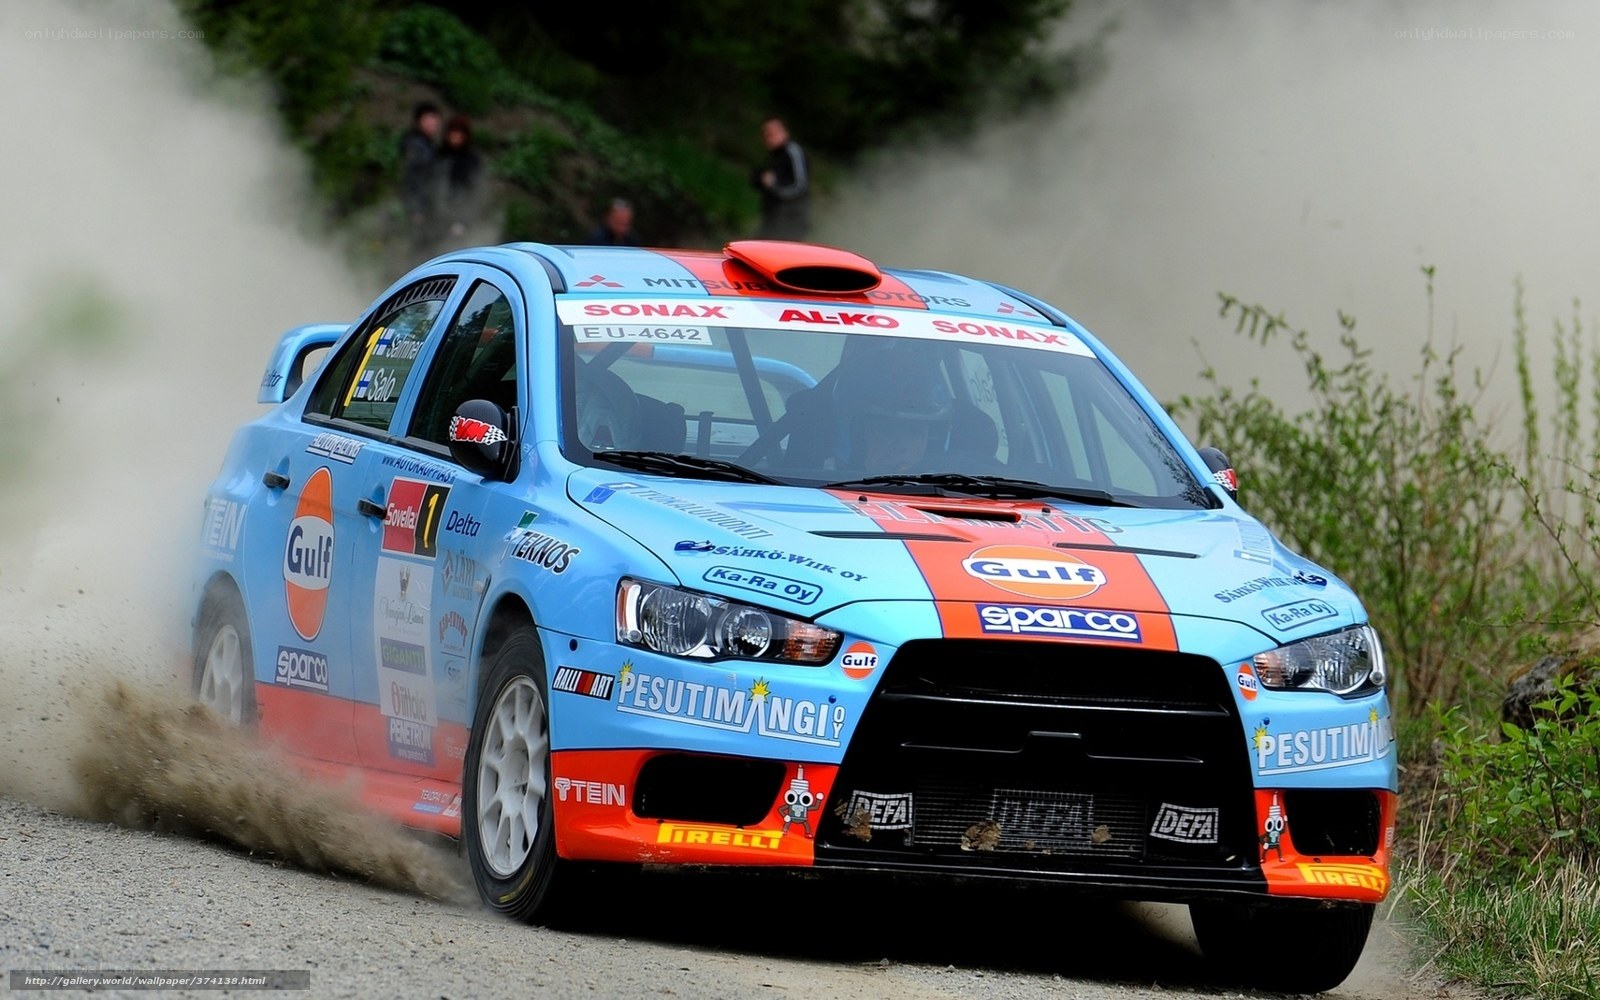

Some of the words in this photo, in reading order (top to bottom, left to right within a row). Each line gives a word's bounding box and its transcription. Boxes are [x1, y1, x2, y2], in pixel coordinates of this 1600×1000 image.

[643, 277, 775, 292] MITSUB
[868, 290, 972, 307] OTORS
[583, 304, 729, 319] SONAX
[778, 309, 902, 330] AL-KO
[583, 327, 702, 341] EU-4642
[932, 319, 1066, 346] SONAX
[344, 326, 385, 407] 1
[367, 367, 396, 402] Salo
[424, 493, 439, 549] 1
[445, 510, 482, 538] Delta
[287, 524, 332, 579] Gulf
[510, 529, 580, 575] TEKNOS
[712, 568, 778, 592] Ka-Ra
[783, 583, 814, 602] Oy
[970, 560, 1097, 583] Gulf
[982, 605, 1138, 634] sparco
[1268, 607, 1312, 626] Ka-Ra
[1308, 602, 1332, 614] Oy
[277, 650, 328, 686] sparco
[842, 654, 877, 669] Gulf
[1237, 674, 1257, 690] Gulf
[618, 671, 828, 738] PESUTIMANGI
[570, 779, 626, 807] TEIN
[853, 796, 907, 824] DEFA
[1158, 809, 1213, 839] DEFA
[656, 822, 784, 850] PIRELLI
